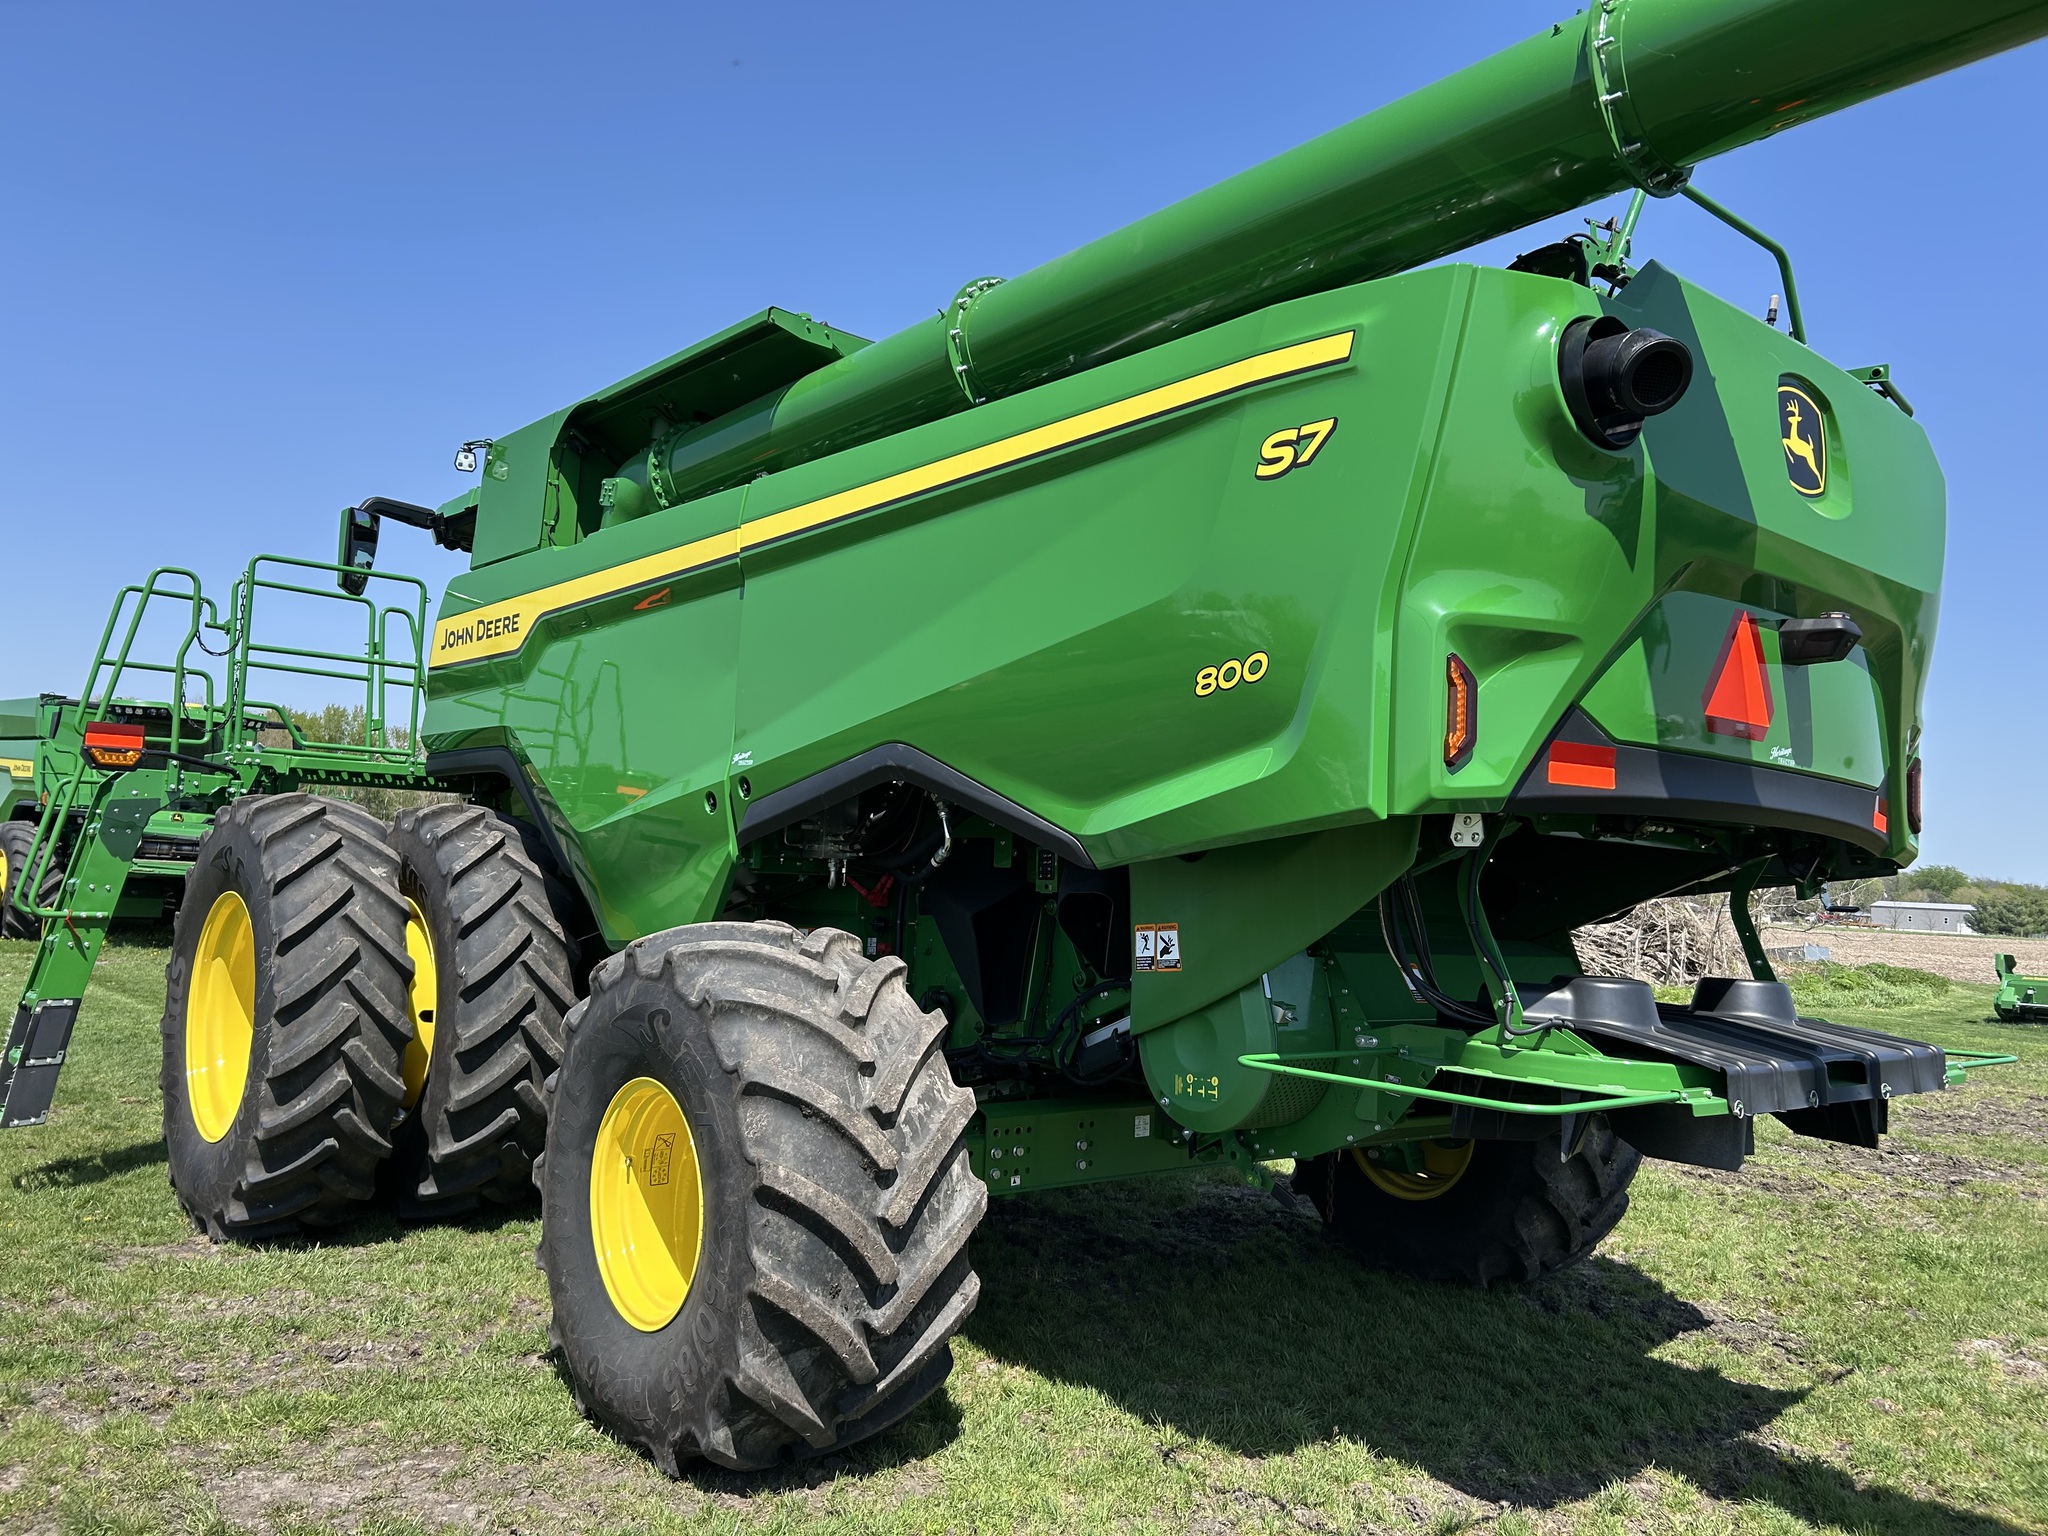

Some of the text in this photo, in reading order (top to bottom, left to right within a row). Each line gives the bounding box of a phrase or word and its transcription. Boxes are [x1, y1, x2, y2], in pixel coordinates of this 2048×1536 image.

[1255, 417, 1338, 480] S7
[440, 613, 520, 650] JOHN DEERE
[1194, 649, 1269, 697] 800
